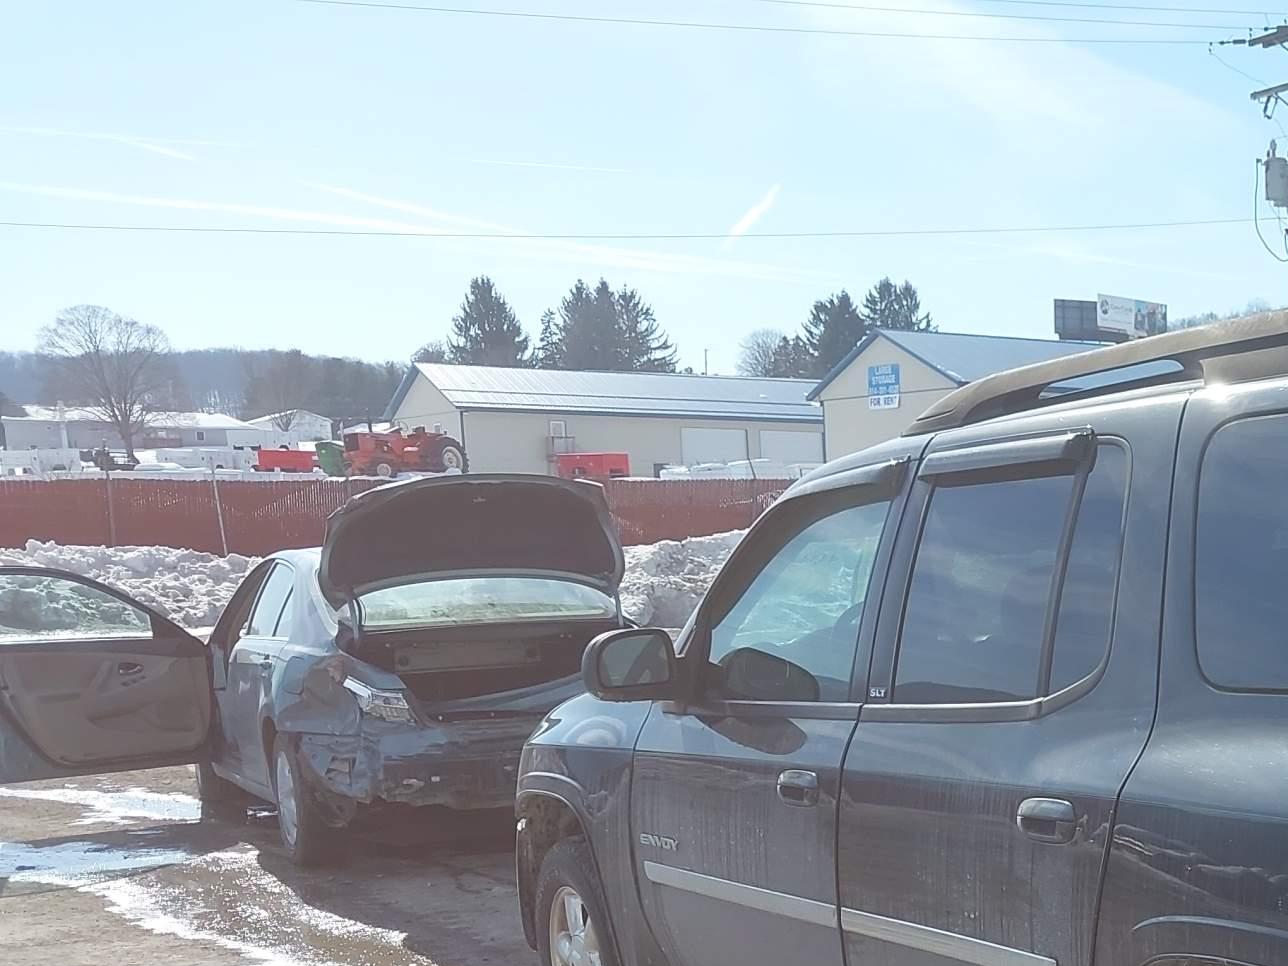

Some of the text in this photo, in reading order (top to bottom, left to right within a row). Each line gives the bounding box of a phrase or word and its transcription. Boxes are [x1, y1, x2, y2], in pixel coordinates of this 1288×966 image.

[870, 396, 897, 407] FOR RENT
[869, 688, 886, 697] SLT
[640, 833, 679, 851] ENVOY
